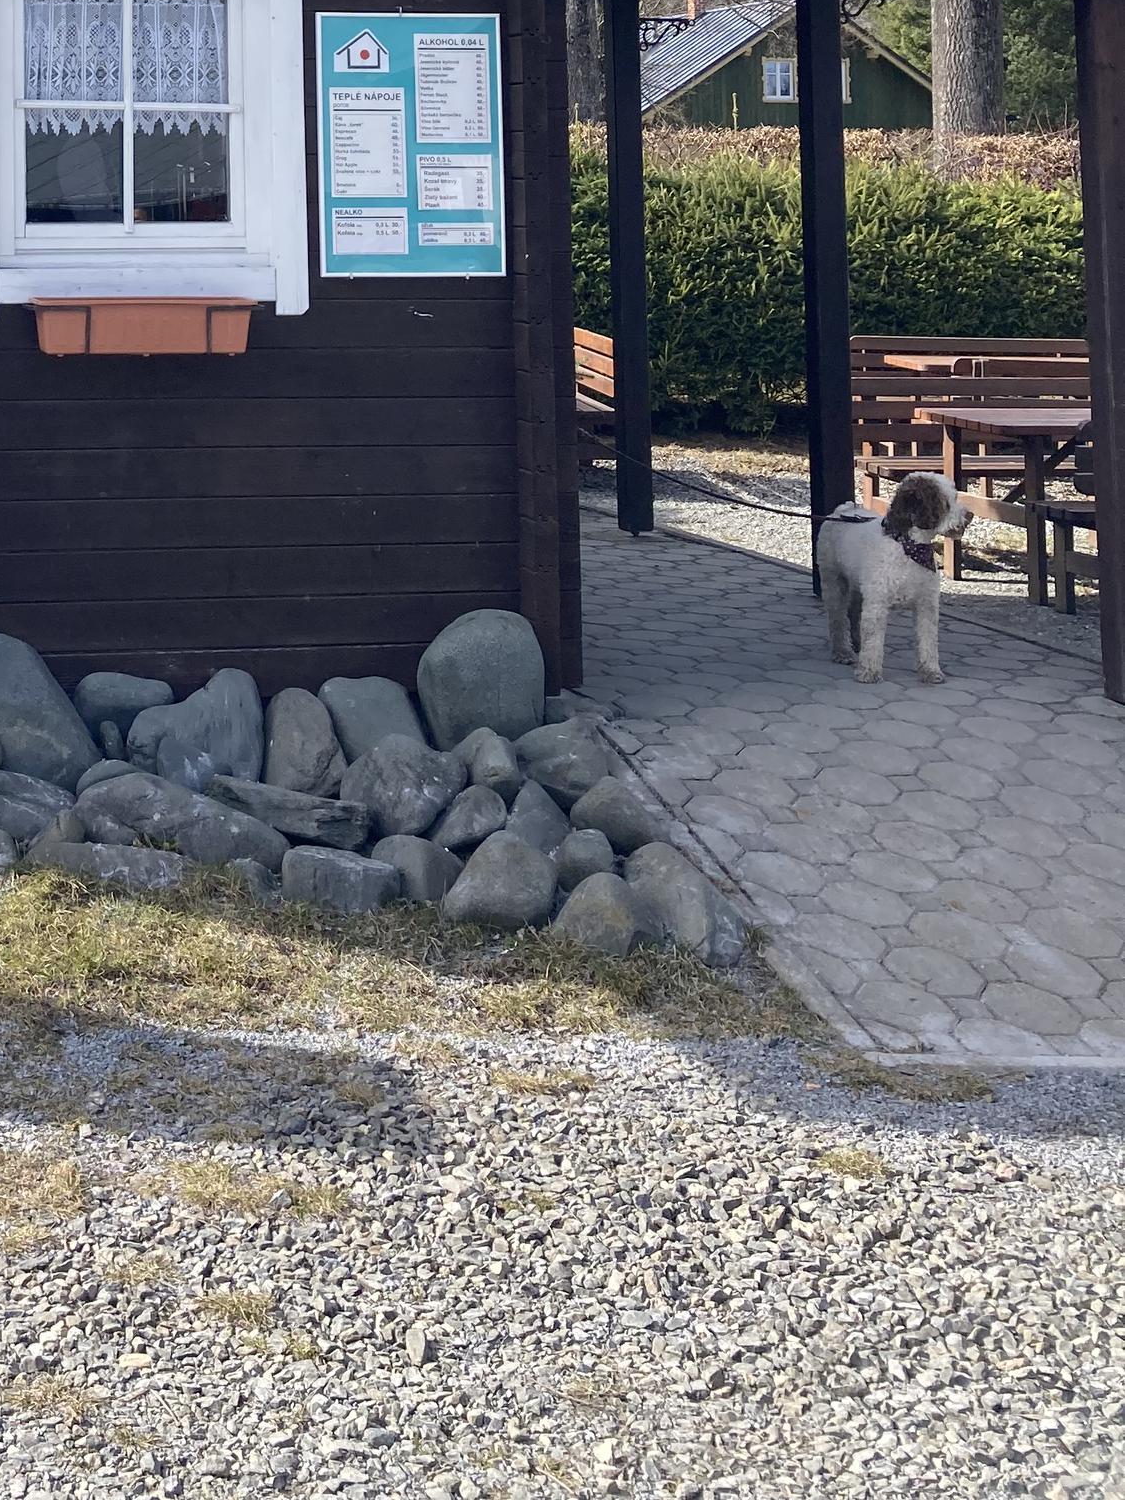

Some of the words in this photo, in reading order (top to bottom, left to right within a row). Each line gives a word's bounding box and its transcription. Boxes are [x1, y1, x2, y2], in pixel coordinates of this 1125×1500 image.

[419, 38, 459, 46] ALKOHOL
[460, 38, 477, 47] 0,04
[332, 90, 362, 101] TEPLÉ
[364, 90, 401, 101] NÁPOJE
[335, 208, 363, 216] NEALKO
